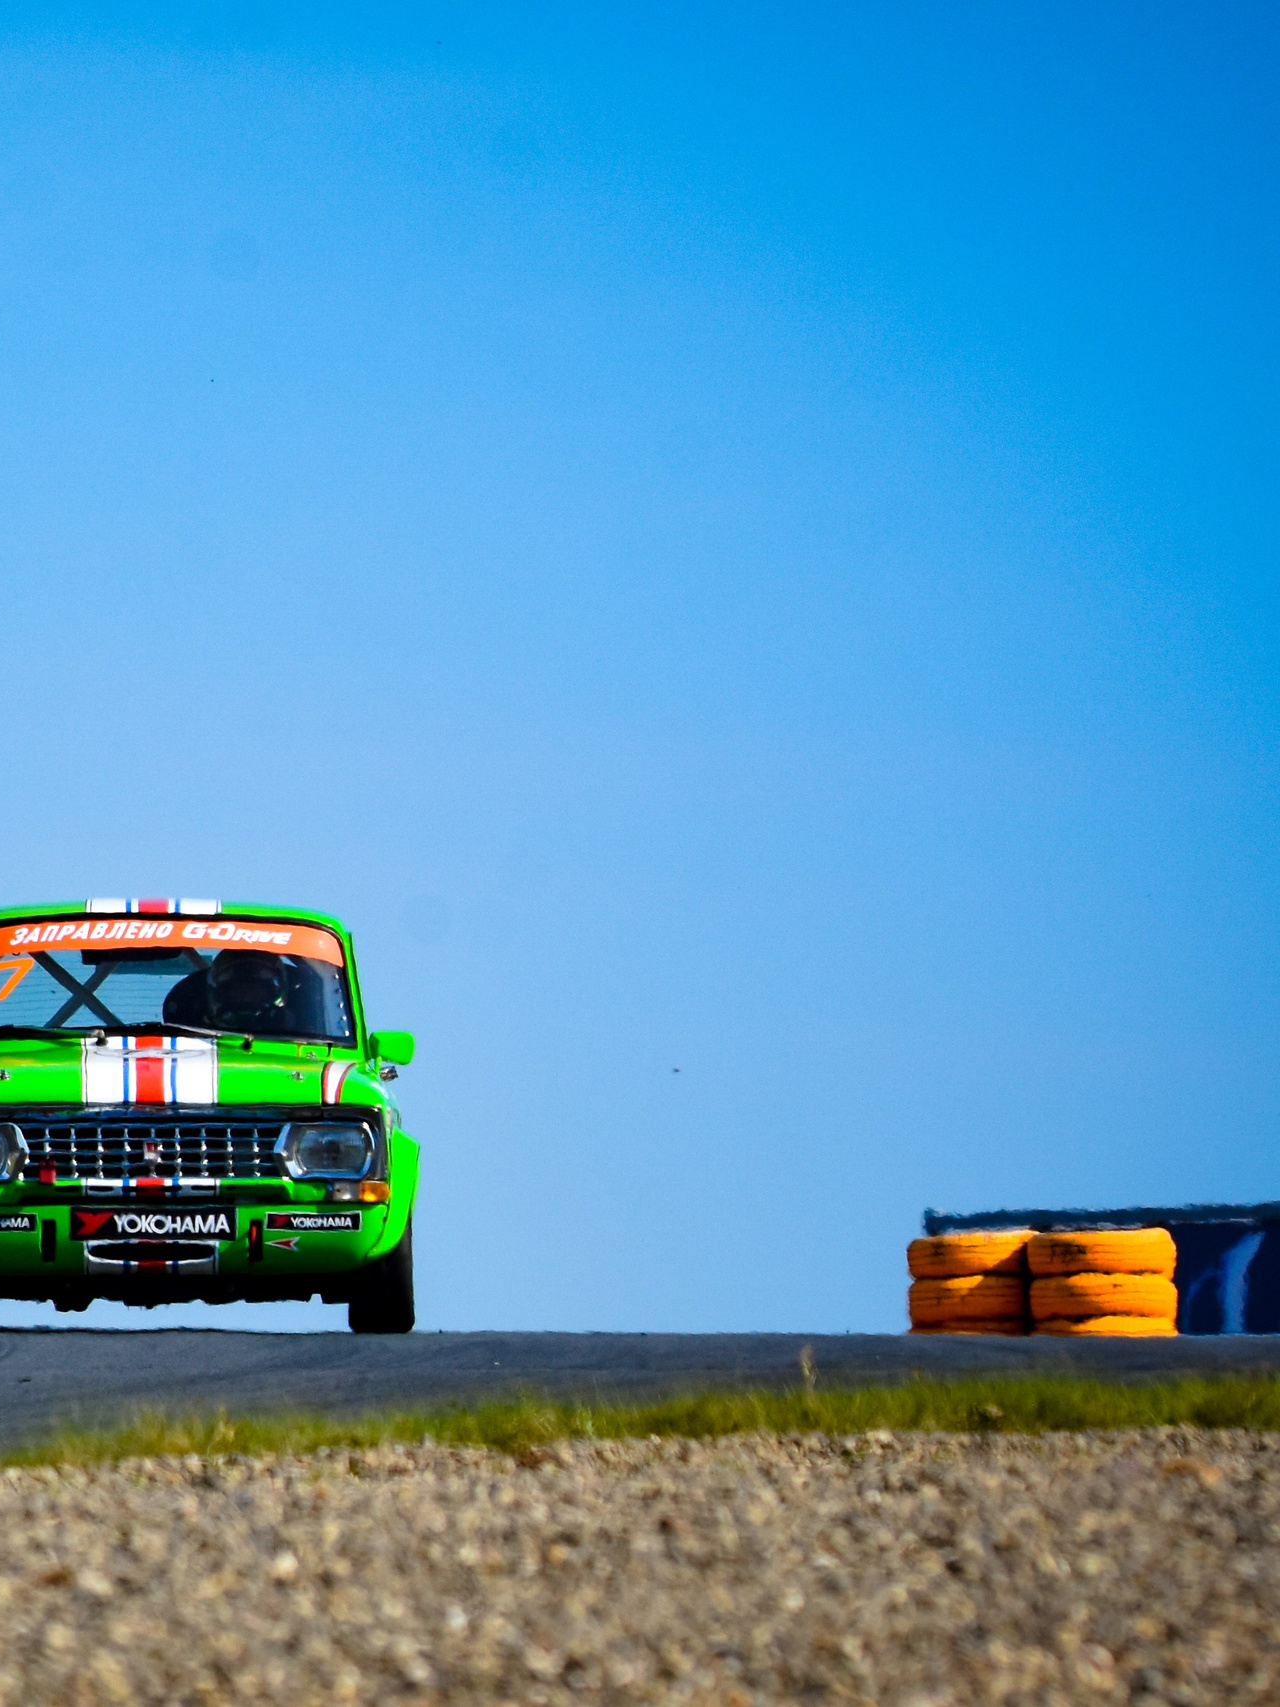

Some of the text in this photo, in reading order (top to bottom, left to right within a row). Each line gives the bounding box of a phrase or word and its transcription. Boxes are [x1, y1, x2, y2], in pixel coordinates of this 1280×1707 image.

[10, 921, 173, 946] ЗАПРАВЛЕНО
[113, 1213, 231, 1235] YOKOHAMA
[290, 1216, 353, 1229] YOKOHAMA
